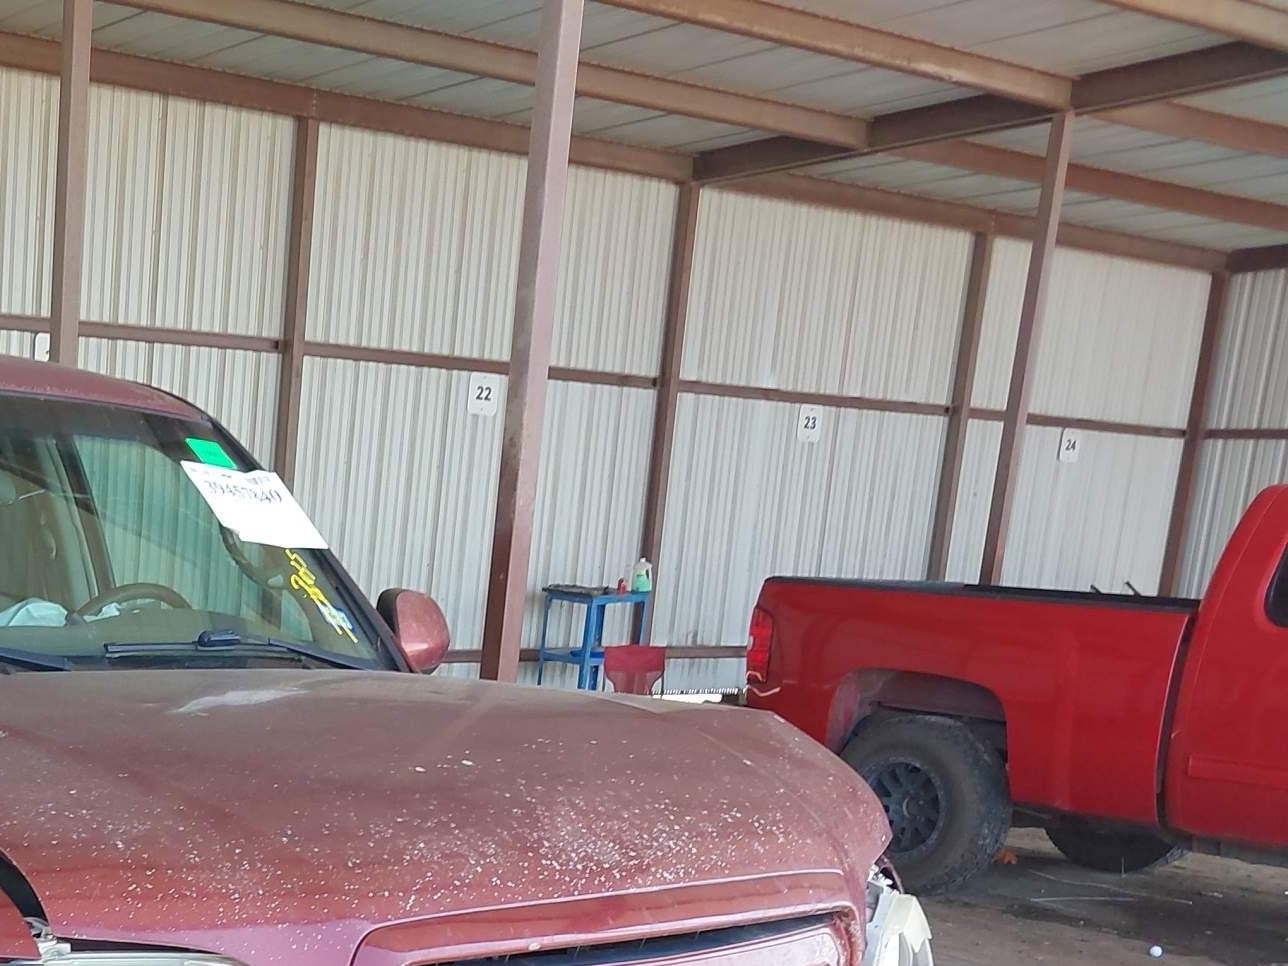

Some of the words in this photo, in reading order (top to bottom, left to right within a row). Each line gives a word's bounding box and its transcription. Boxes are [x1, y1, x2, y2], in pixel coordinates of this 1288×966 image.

[475, 385, 492, 401] 22
[804, 415, 817, 430] 23
[1065, 438, 1077, 451] 24
